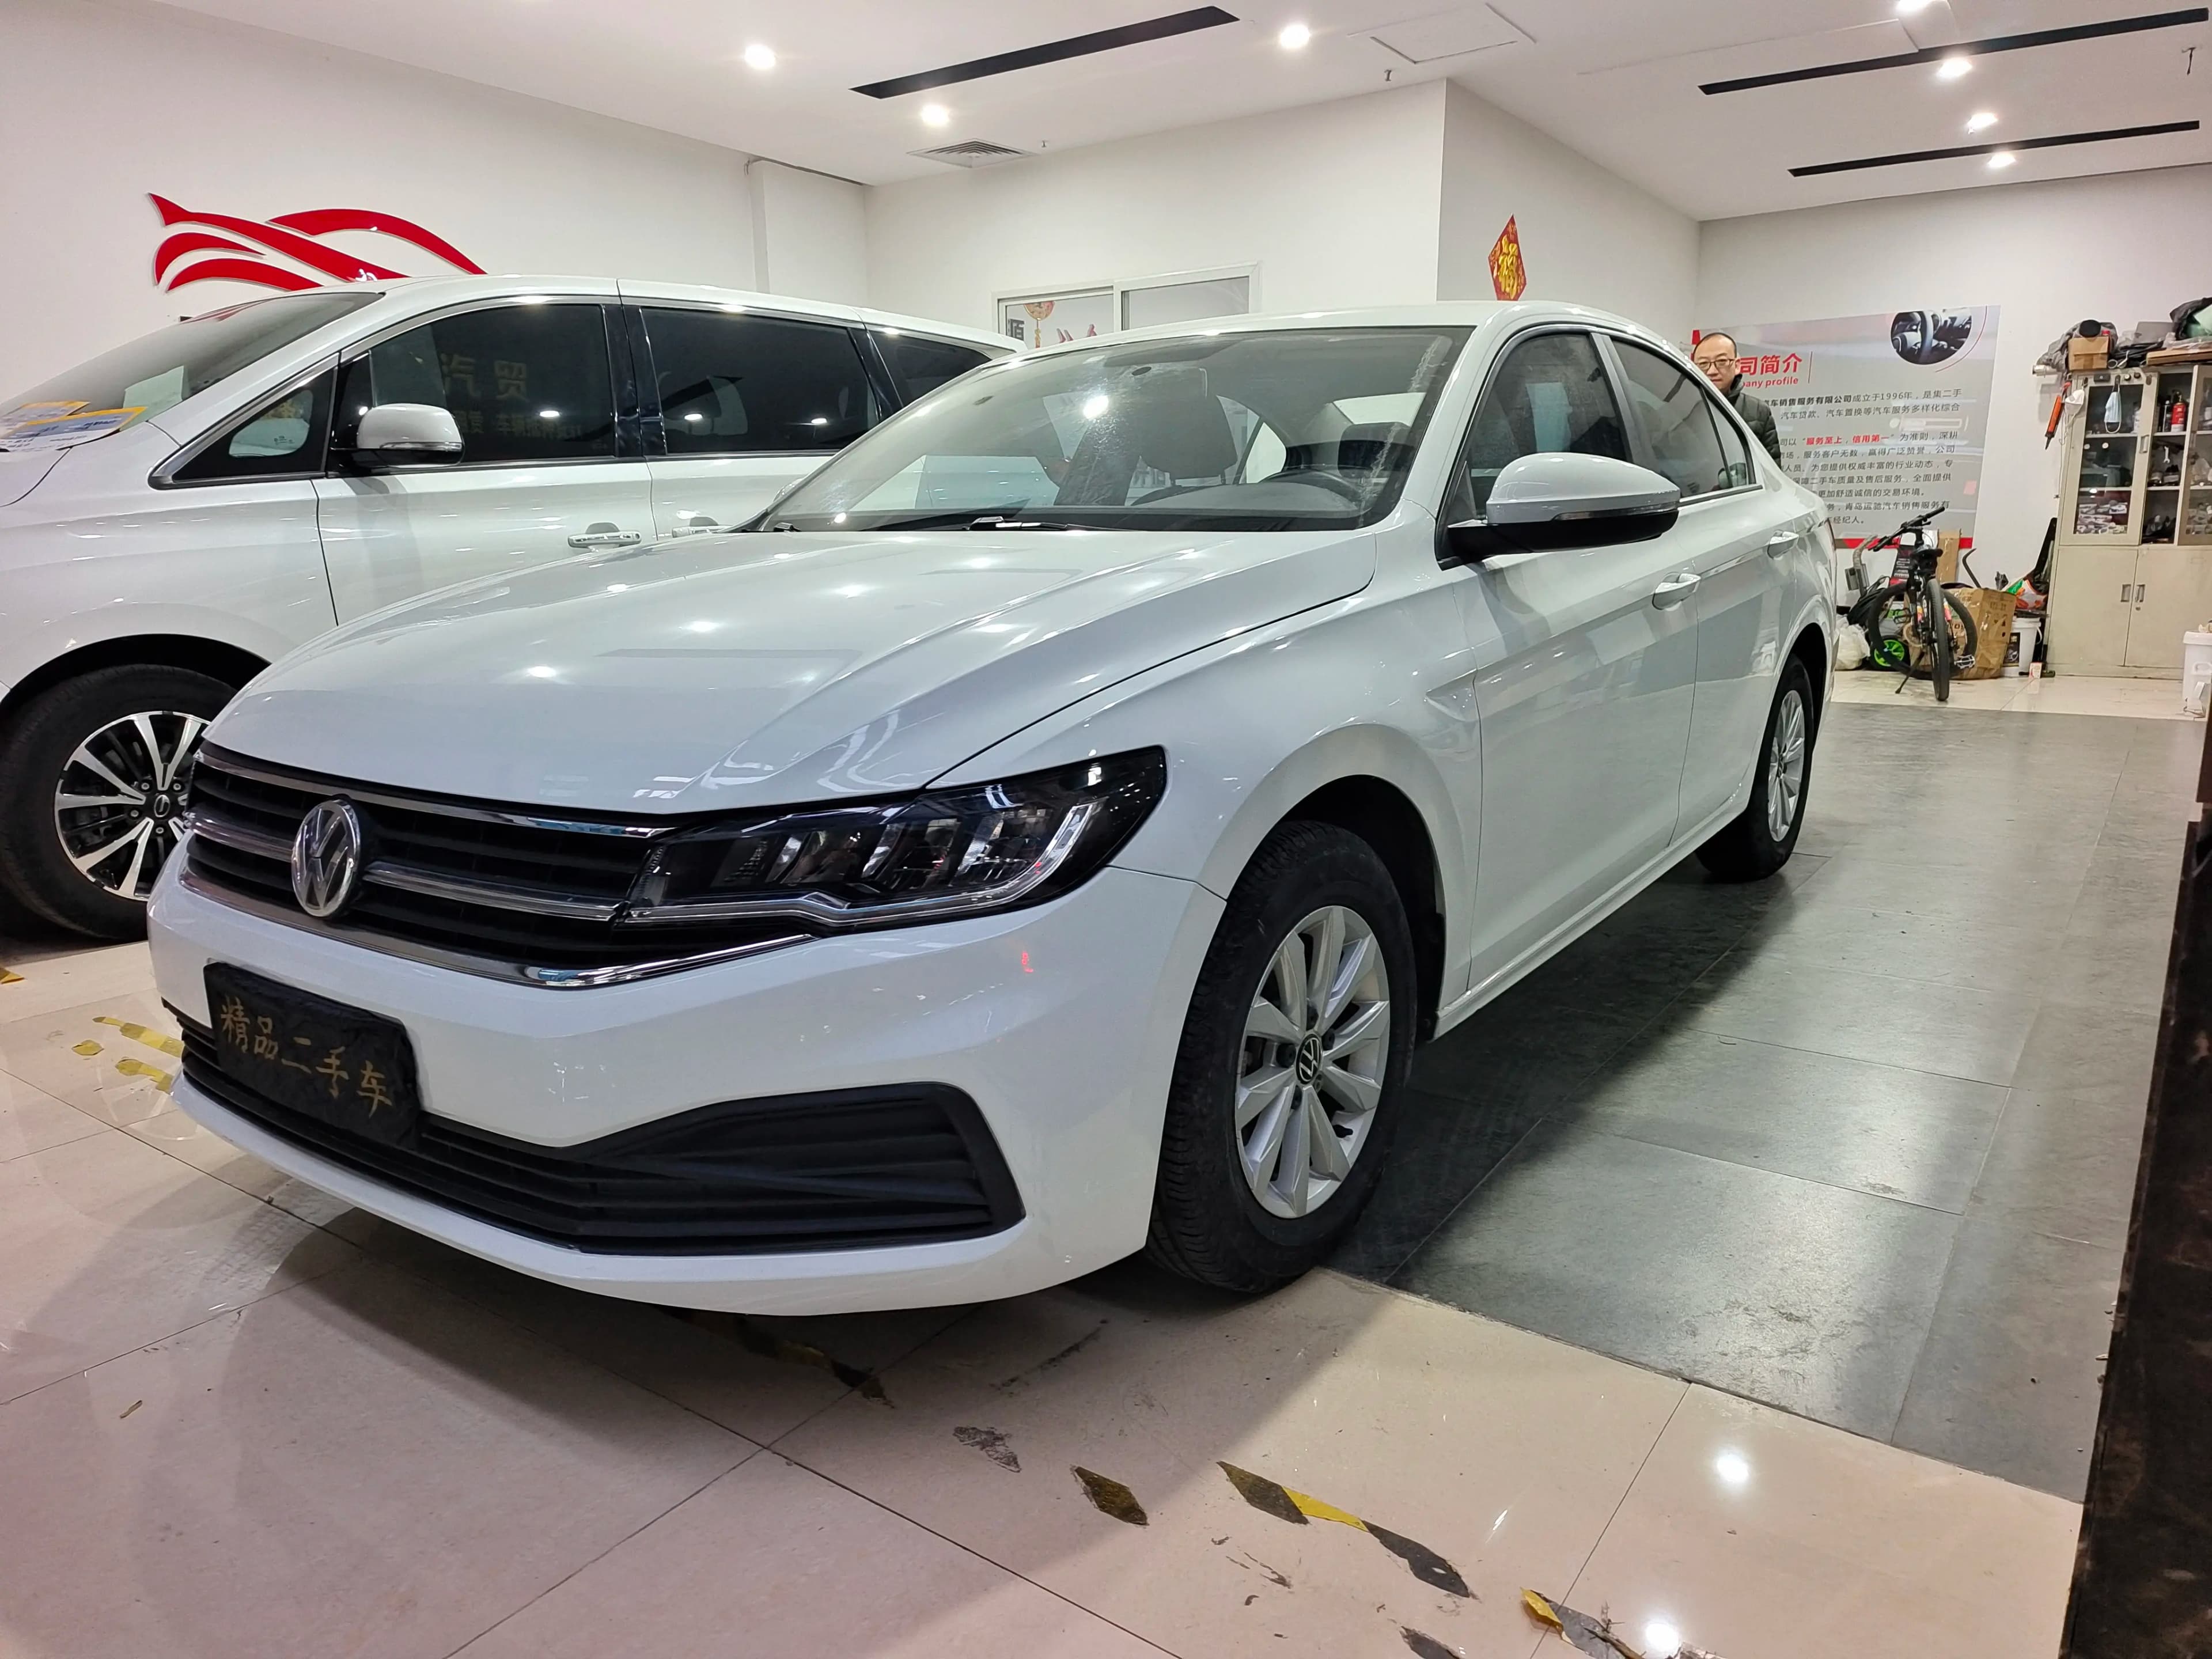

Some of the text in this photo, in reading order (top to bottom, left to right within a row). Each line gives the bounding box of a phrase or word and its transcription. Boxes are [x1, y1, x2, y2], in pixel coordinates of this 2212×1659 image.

[1740, 353, 1802, 376] 司简介
[1765, 376, 1798, 388] profile
[1812, 488, 1924, 498] 更加舒适诚信的交易环境。
[221, 995, 392, 1119] 精品二手车
